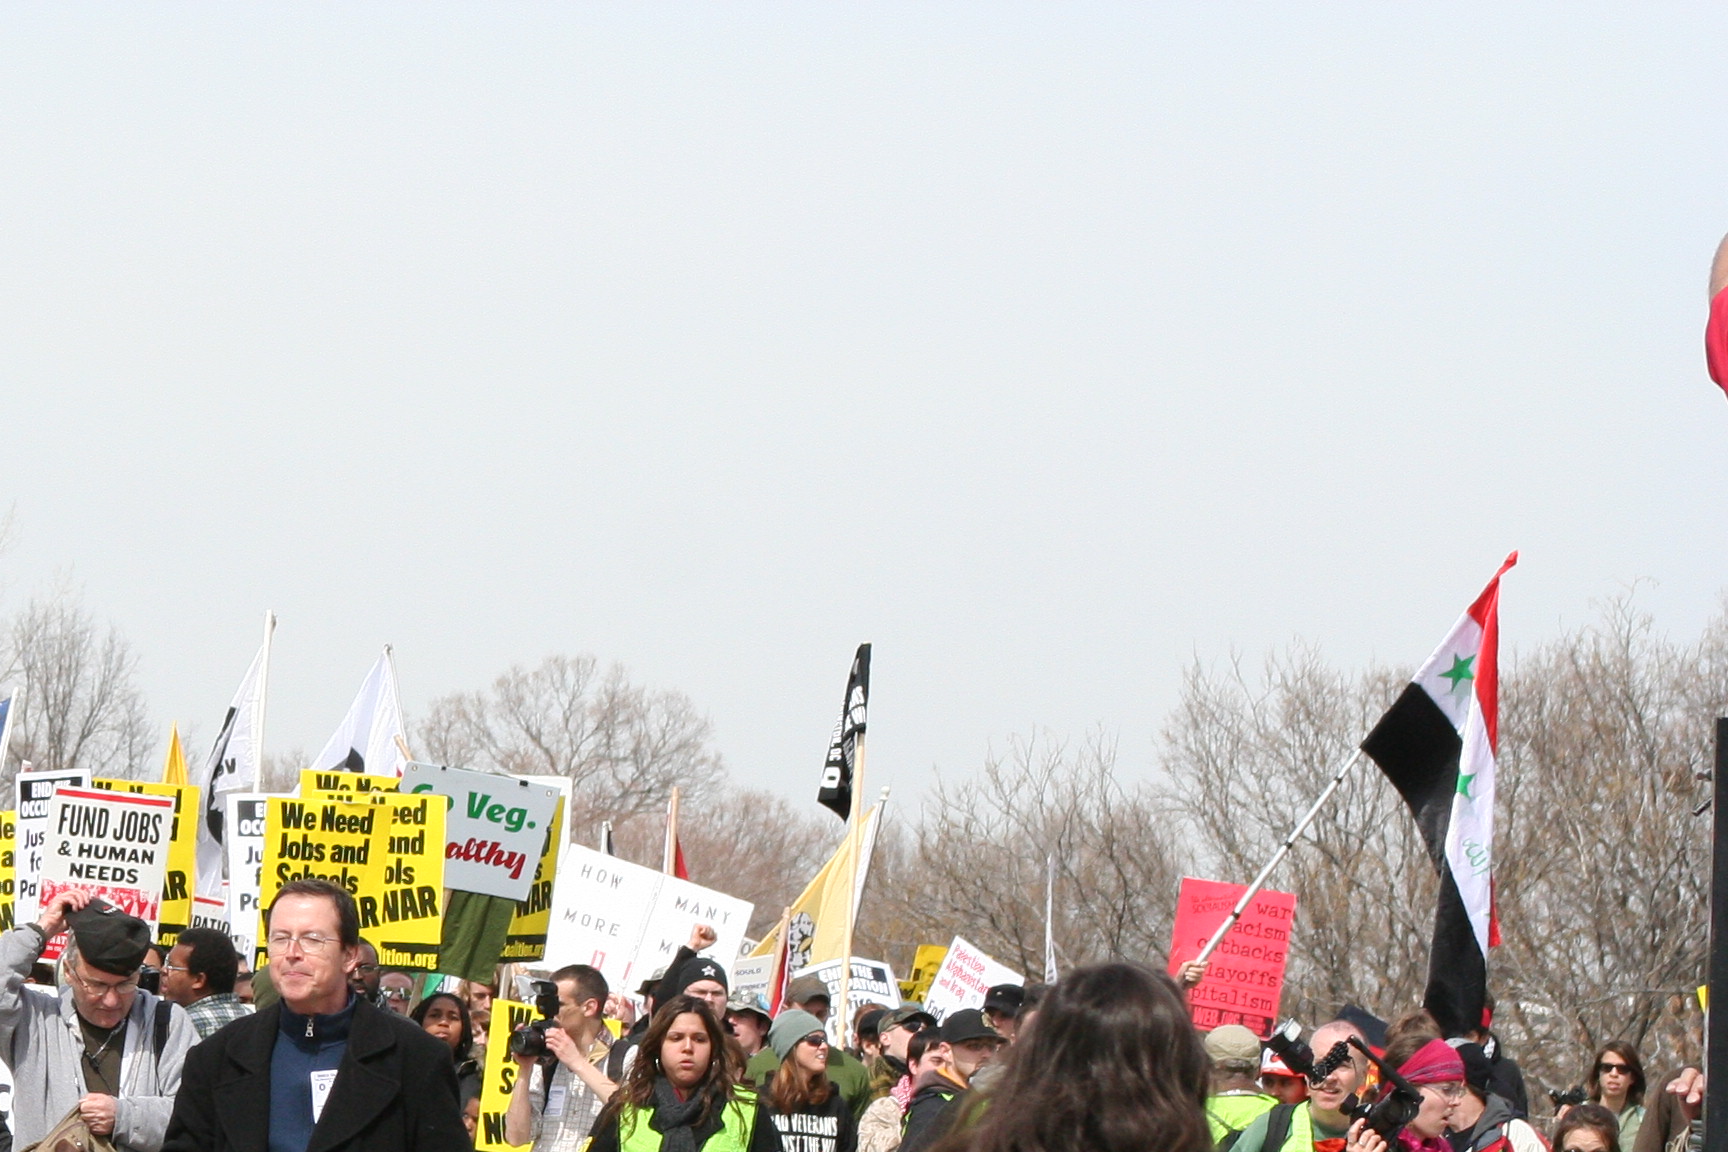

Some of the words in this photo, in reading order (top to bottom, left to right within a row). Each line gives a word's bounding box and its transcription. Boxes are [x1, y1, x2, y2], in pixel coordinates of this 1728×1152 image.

[31, 781, 52, 799] END
[58, 804, 110, 839] FUND
[113, 809, 163, 844] JOBS
[280, 802, 316, 830] We
[320, 805, 374, 835] Need
[467, 791, 536, 833] Veg.
[57, 840, 72, 856] &
[78, 843, 155, 865] HUMAN
[277, 833, 326, 862] Jobs
[330, 838, 370, 865] and
[445, 837, 526, 880] althy
[69, 863, 139, 884] NEEDS
[581, 864, 623, 890] HOW
[675, 896, 731, 925] MANY
[563, 907, 621, 937] MORE
[1256, 903, 1292, 920] war
[1232, 922, 1287, 942] acism
[377, 948, 437, 970] lition.org
[952, 944, 986, 975] Palestine
[1197, 937, 1284, 963] ctbacks
[850, 964, 873, 979] THE
[926, 999, 946, 1020] End
[1190, 985, 1273, 1011] pitalism
[791, 1113, 838, 1137] VETERANS
